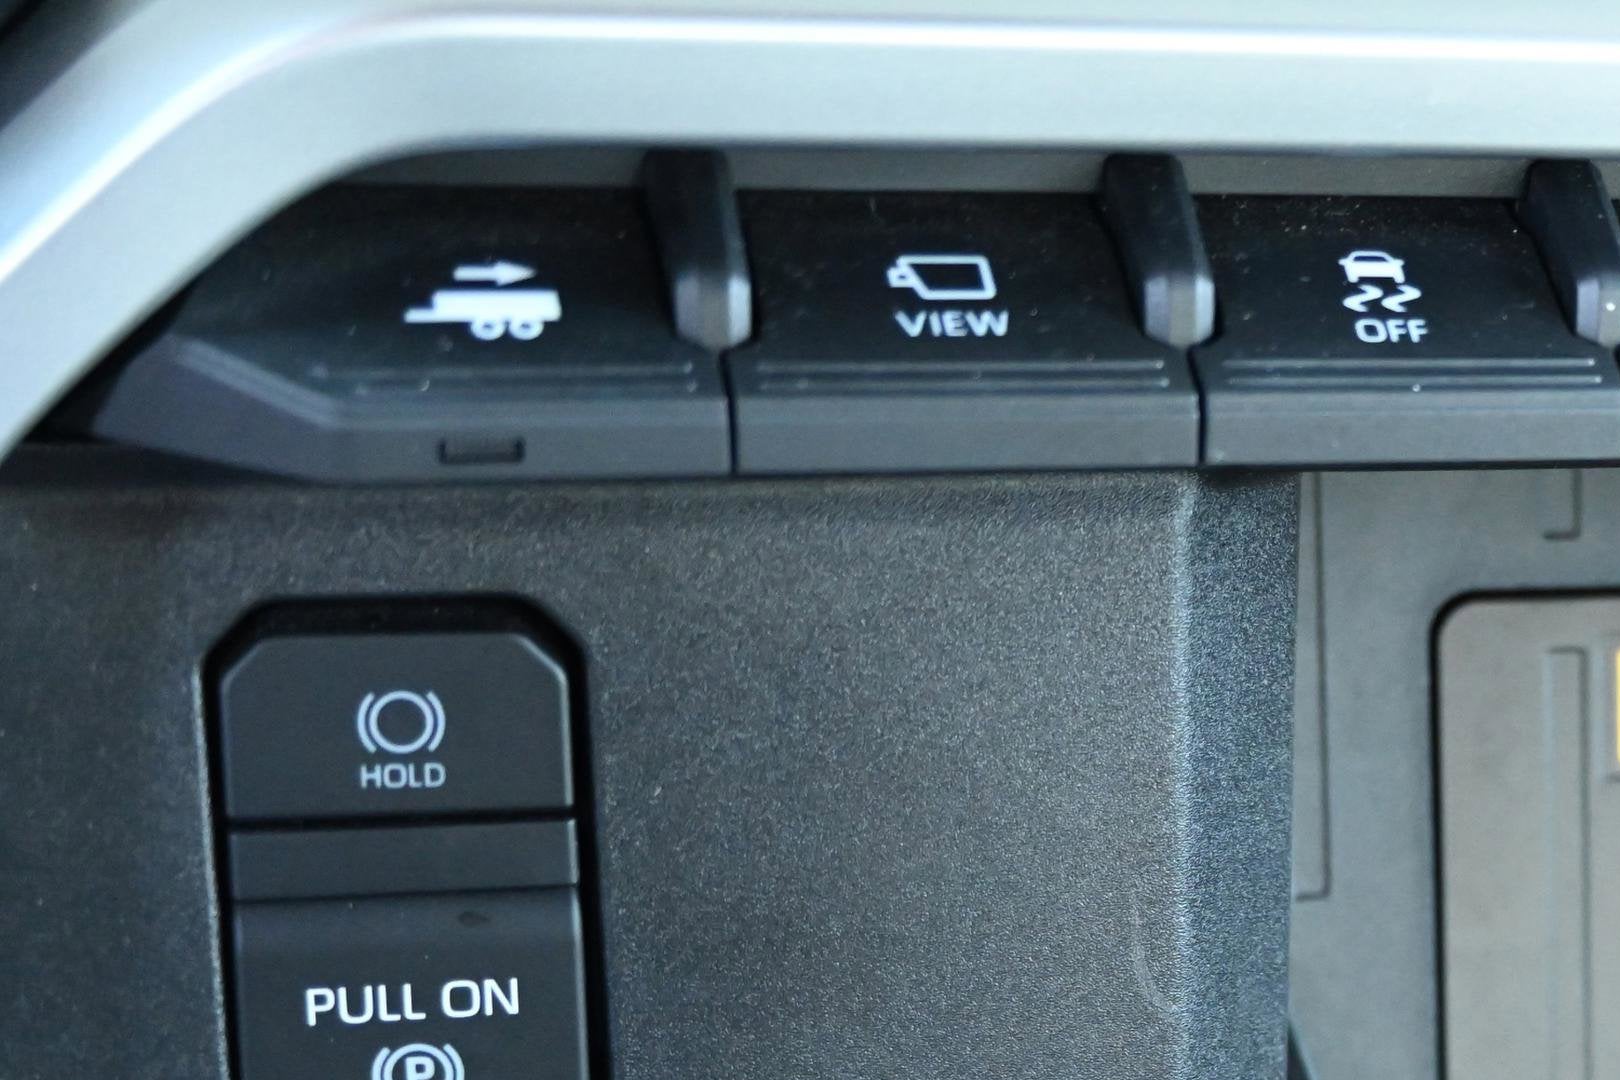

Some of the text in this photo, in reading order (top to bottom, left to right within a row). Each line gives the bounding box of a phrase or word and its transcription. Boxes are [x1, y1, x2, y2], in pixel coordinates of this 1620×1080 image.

[895, 310, 1009, 338] VIEW
[1353, 318, 1430, 345] OFF
[359, 762, 447, 789] HOLD
[304, 976, 520, 1028] PULL ON
